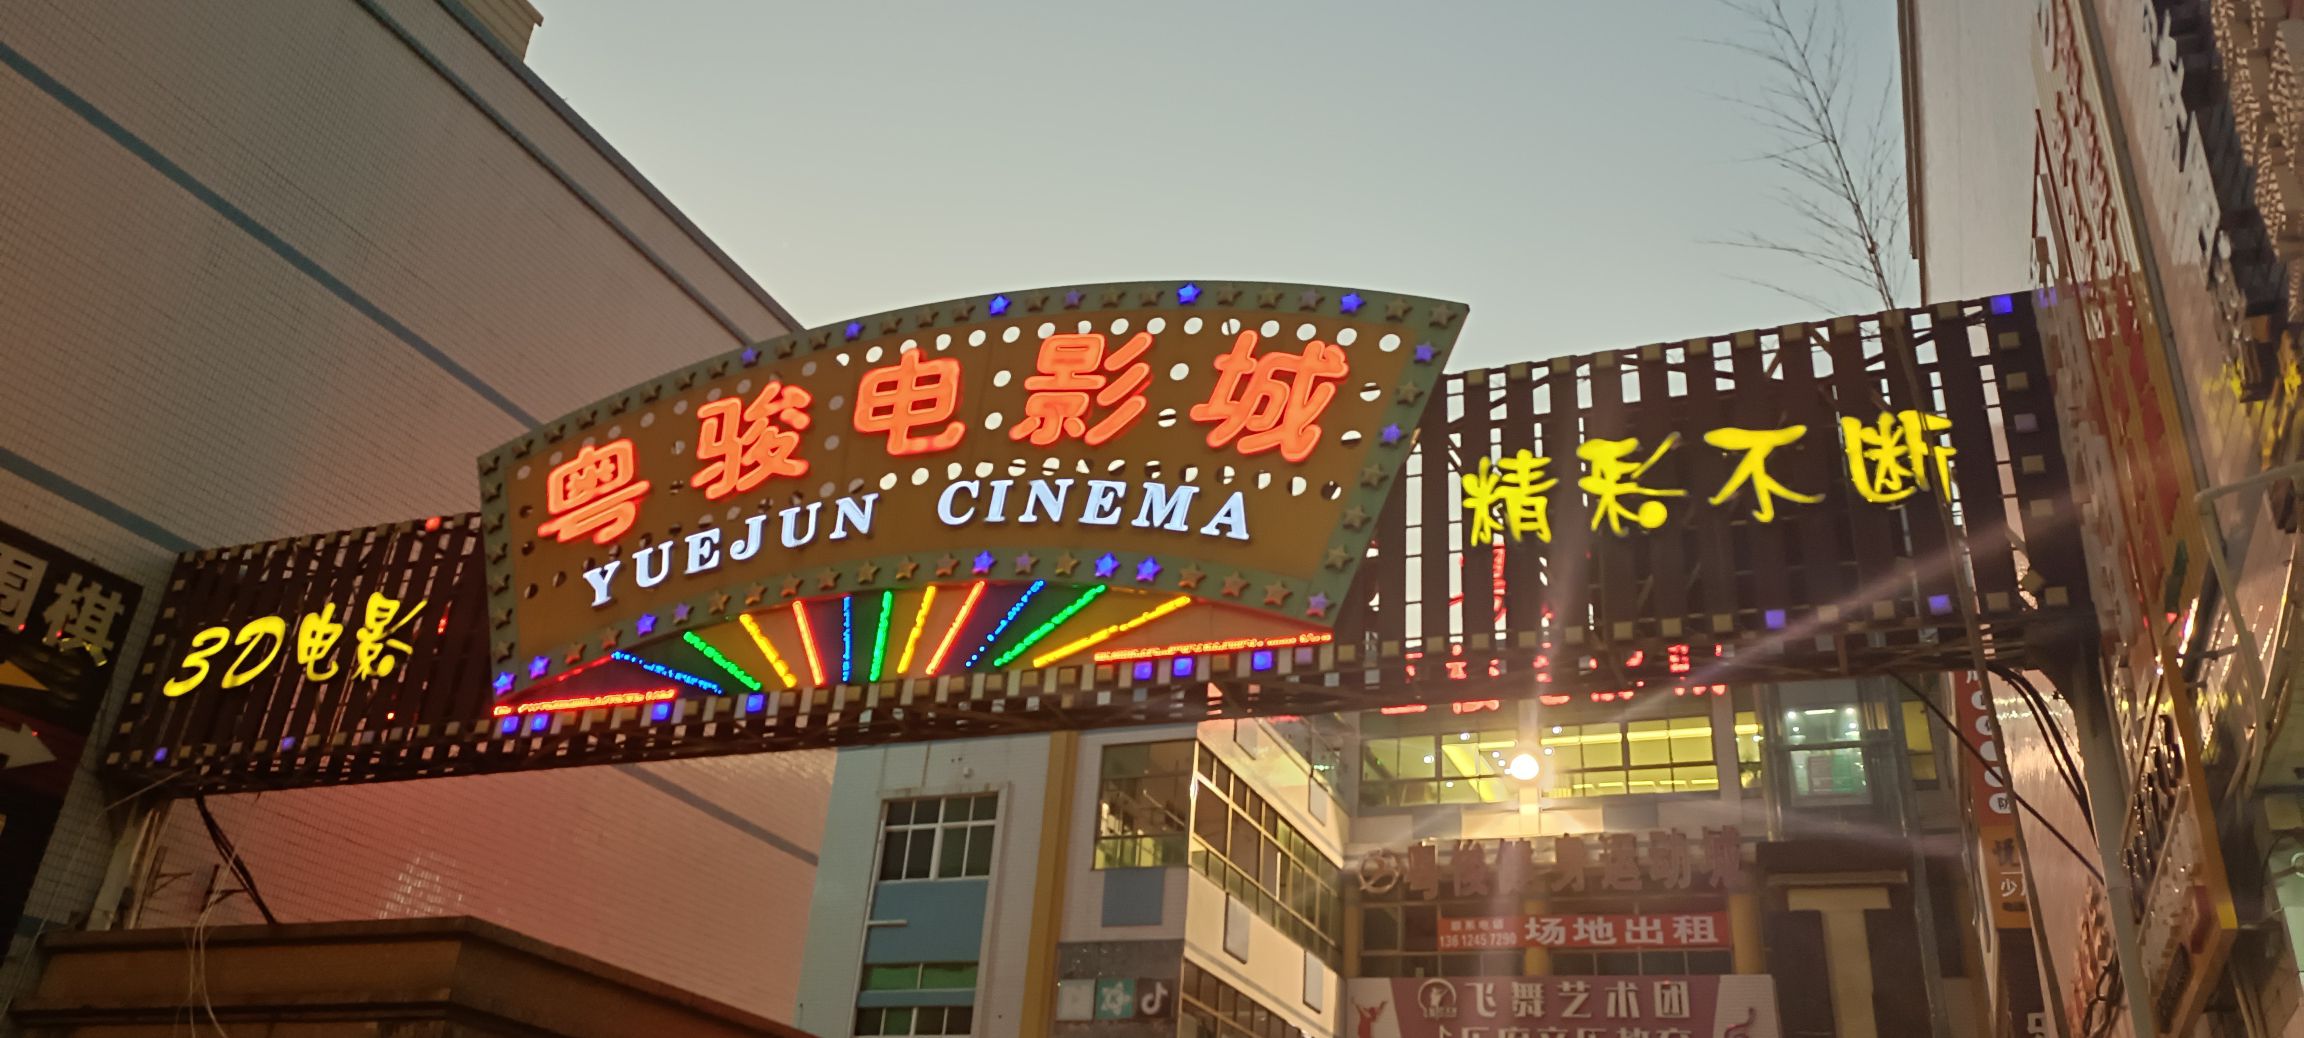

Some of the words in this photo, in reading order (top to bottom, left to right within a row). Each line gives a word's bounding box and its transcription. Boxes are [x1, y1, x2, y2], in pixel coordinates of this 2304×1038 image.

[538, 329, 1349, 545] 粤骏电影城
[1462, 411, 1956, 546] 精彩不断
[583, 491, 881, 608] YUEJUN
[936, 477, 1252, 541] CINEMA
[163, 592, 428, 697] 3D电影
[1524, 915, 1718, 944] 场地出租
[1465, 981, 1690, 1018] 飞舞艺术团
